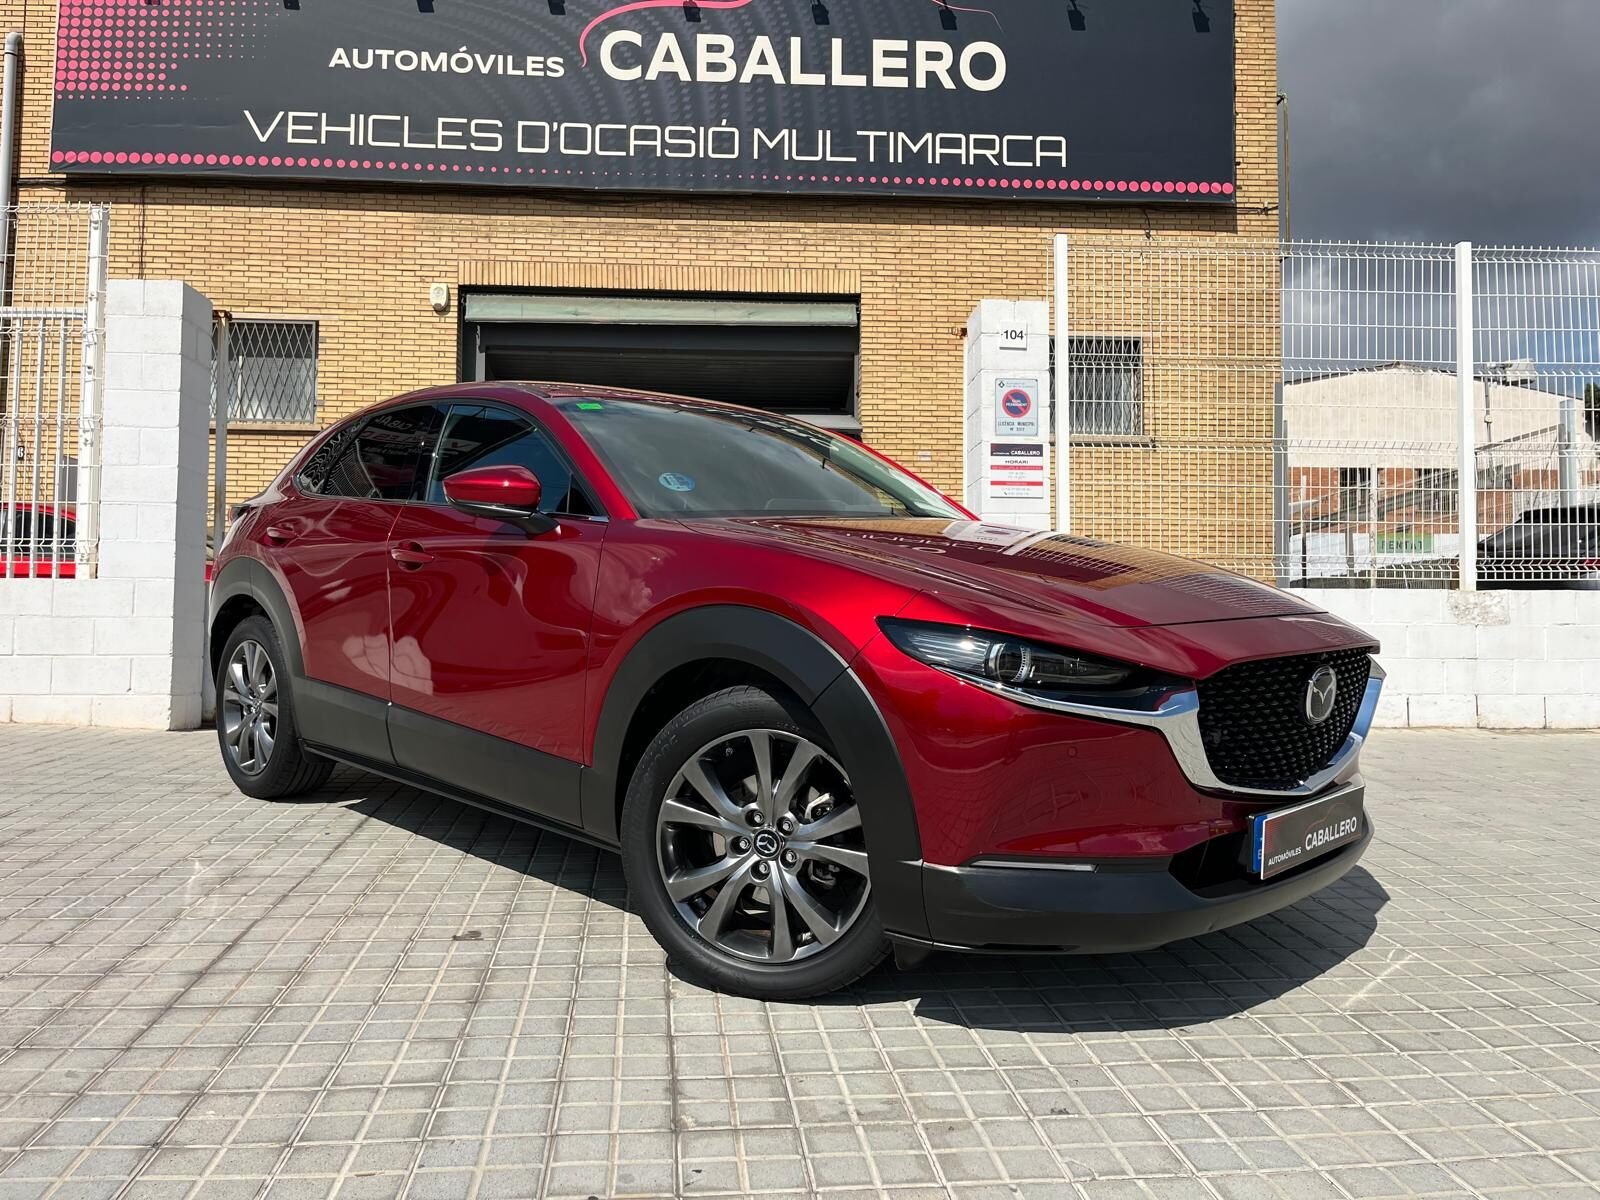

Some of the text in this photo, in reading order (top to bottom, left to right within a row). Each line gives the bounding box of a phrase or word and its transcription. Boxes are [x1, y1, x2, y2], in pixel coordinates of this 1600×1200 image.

[328, 29, 1006, 92] AUTOMÓVILES CABALLERO
[243, 110, 1067, 168] VEHICLES D'OCASIÓ MULTIMARCA
[1003, 329, 1025, 341] 104
[1268, 816, 1357, 866] AUTOMÓVILES CABALLERO
